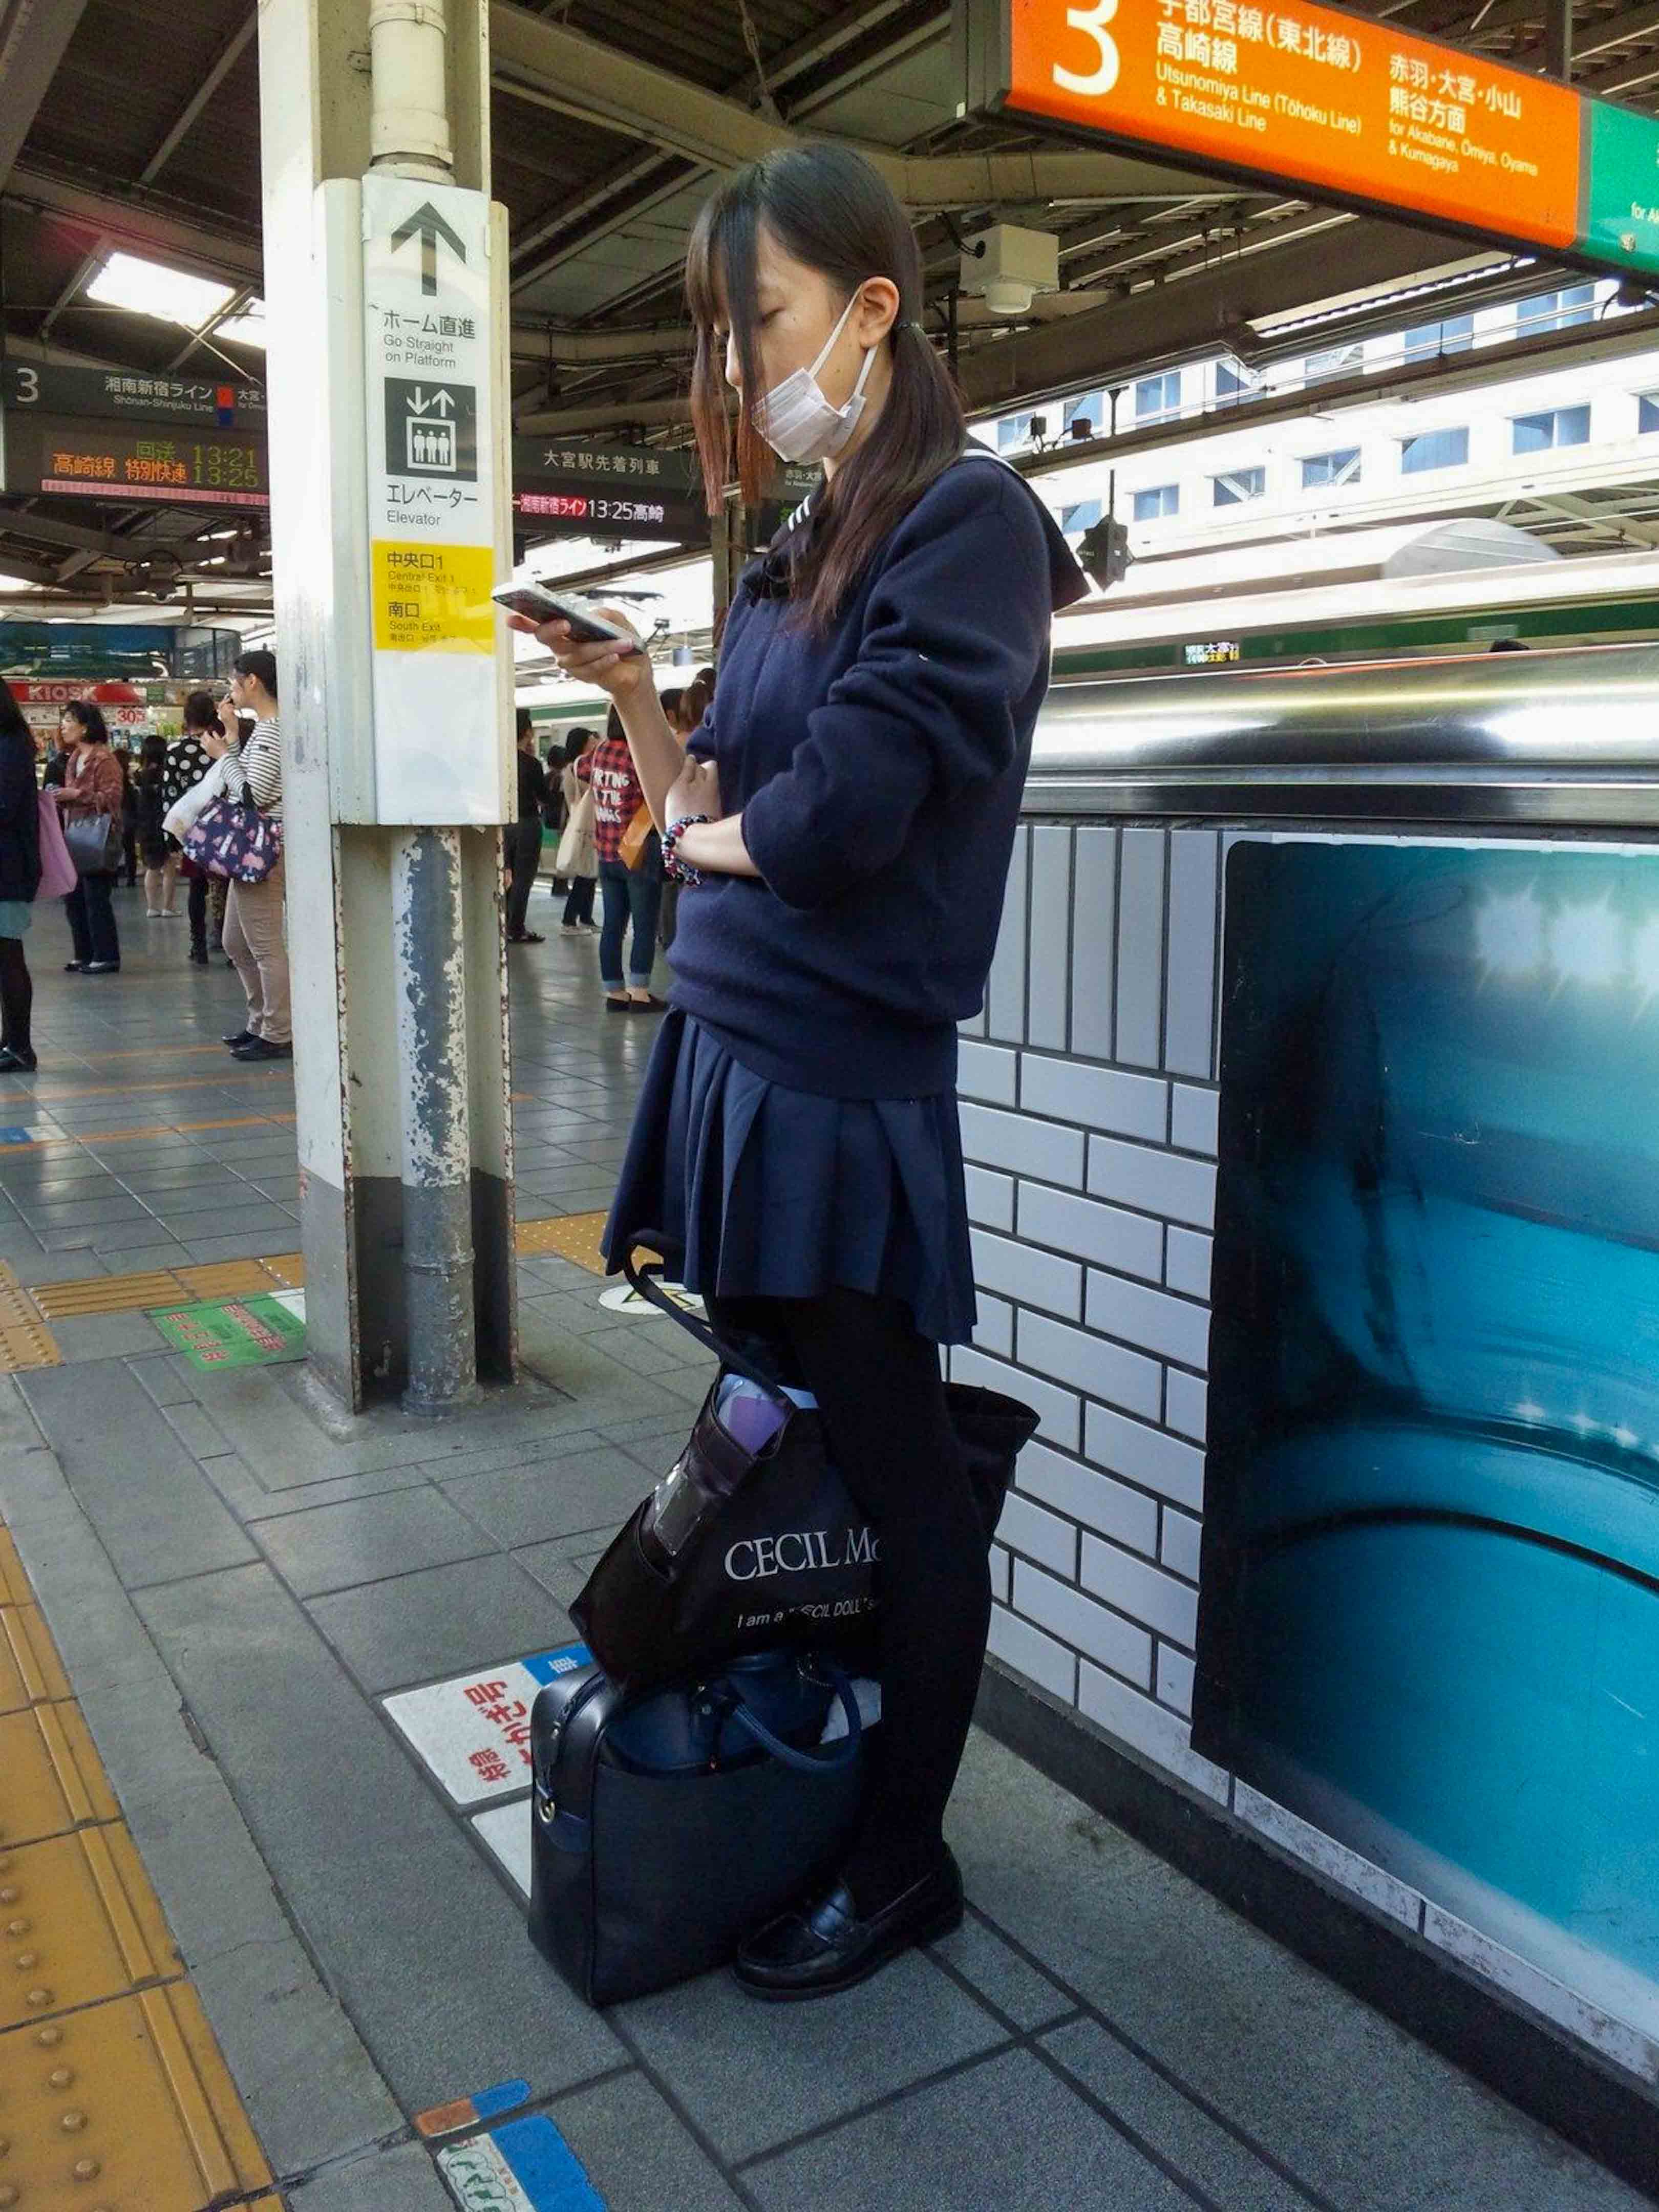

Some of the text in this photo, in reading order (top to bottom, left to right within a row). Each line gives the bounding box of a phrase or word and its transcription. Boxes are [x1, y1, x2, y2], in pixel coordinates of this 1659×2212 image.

[1052, 0, 1120, 96] 3
[1156, 21, 1238, 74] 高崎線
[1156, 59, 1238, 102] Utsunomiya
[1242, 83, 1270, 110] Line
[1330, 110, 1362, 137] Line)
[1156, 86, 1267, 132] & Takasaki Line
[1389, 86, 1466, 135] 熊谷方面
[1389, 117, 1403, 136] for
[1388, 139, 1459, 173] & Kumagaya
[384, 310, 476, 339] ホーム直進
[384, 334, 454, 354] Go Straight
[385, 351, 456, 368] on Platform
[16, 367, 39, 403] 3
[105, 376, 213, 398] 湘南新宿ライン
[193, 402, 213, 413] Line
[137, 441, 256, 469] 回送 13:21
[544, 449, 661, 476] 大宮駅先着列車
[53, 453, 258, 488] 高崎線 特別快速 13:25
[387, 484, 478, 508] エレベーター
[387, 509, 441, 525] Elevator
[387, 551, 443, 570] 中央口1
[428, 572, 446, 582] Exit
[388, 601, 420, 618] 南口
[389, 620, 442, 632] South Exit
[28, 684, 98, 702] KIOSK
[725, 1530, 840, 1581] CECIL
[746, 1614, 771, 1627] am
